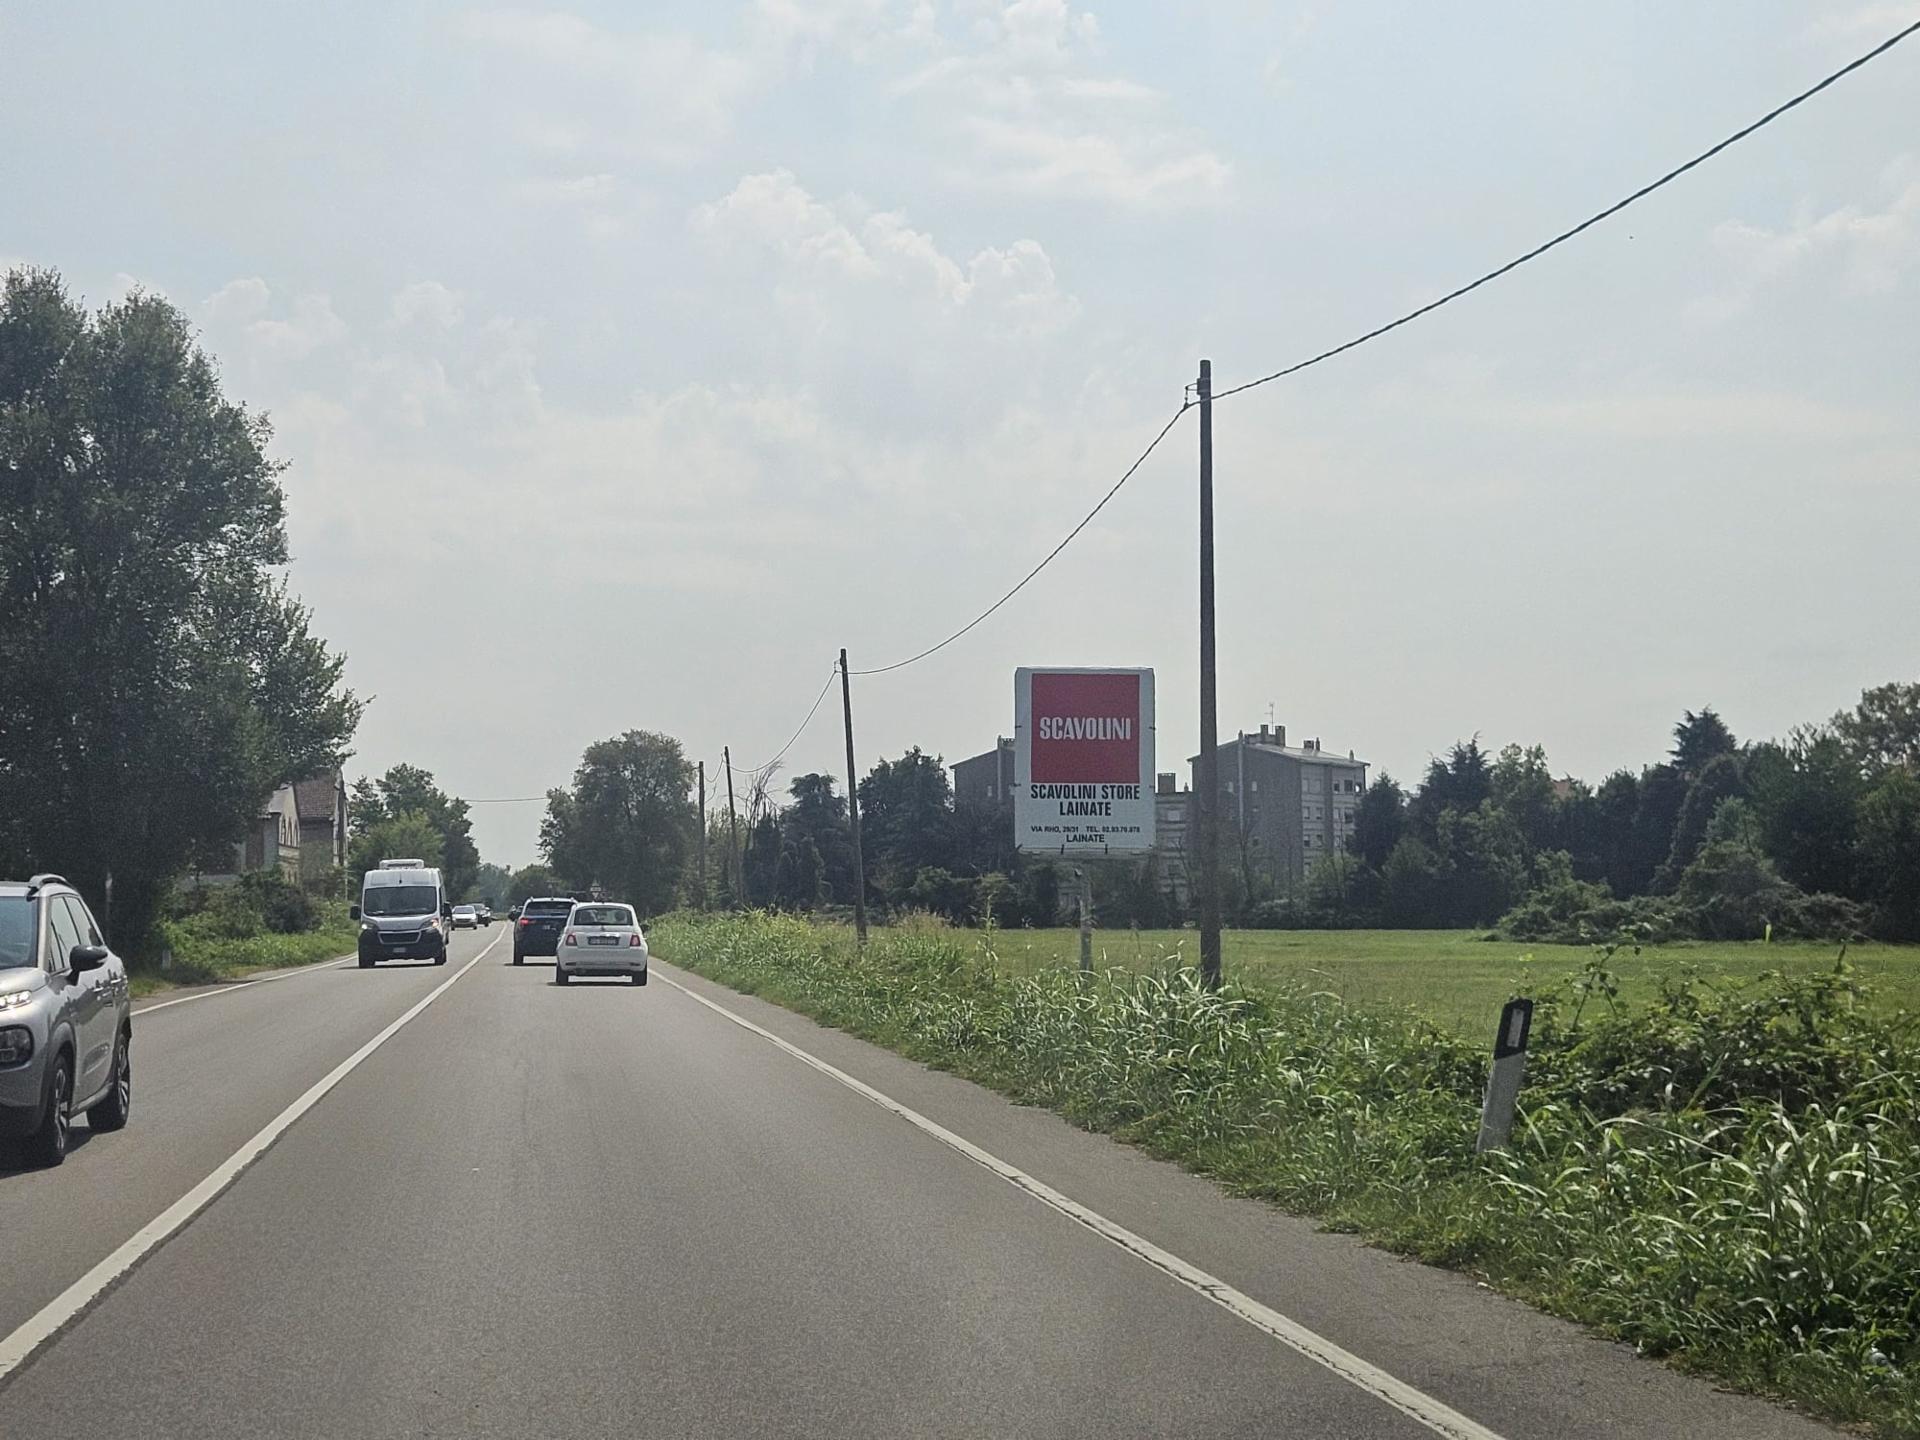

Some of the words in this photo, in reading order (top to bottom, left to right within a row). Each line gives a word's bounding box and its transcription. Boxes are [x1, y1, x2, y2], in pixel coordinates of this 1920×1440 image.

[1039, 716, 1132, 741] SCAVOLINI
[1030, 784, 1096, 800] SCAVOLINI
[1101, 784, 1140, 800] STORE
[1059, 801, 1112, 816] LAINATE
[1031, 825, 1043, 833] VIA
[1044, 825, 1061, 834] RHO,
[1086, 825, 1101, 833] TEL.
[1066, 834, 1105, 843] LAINATE
